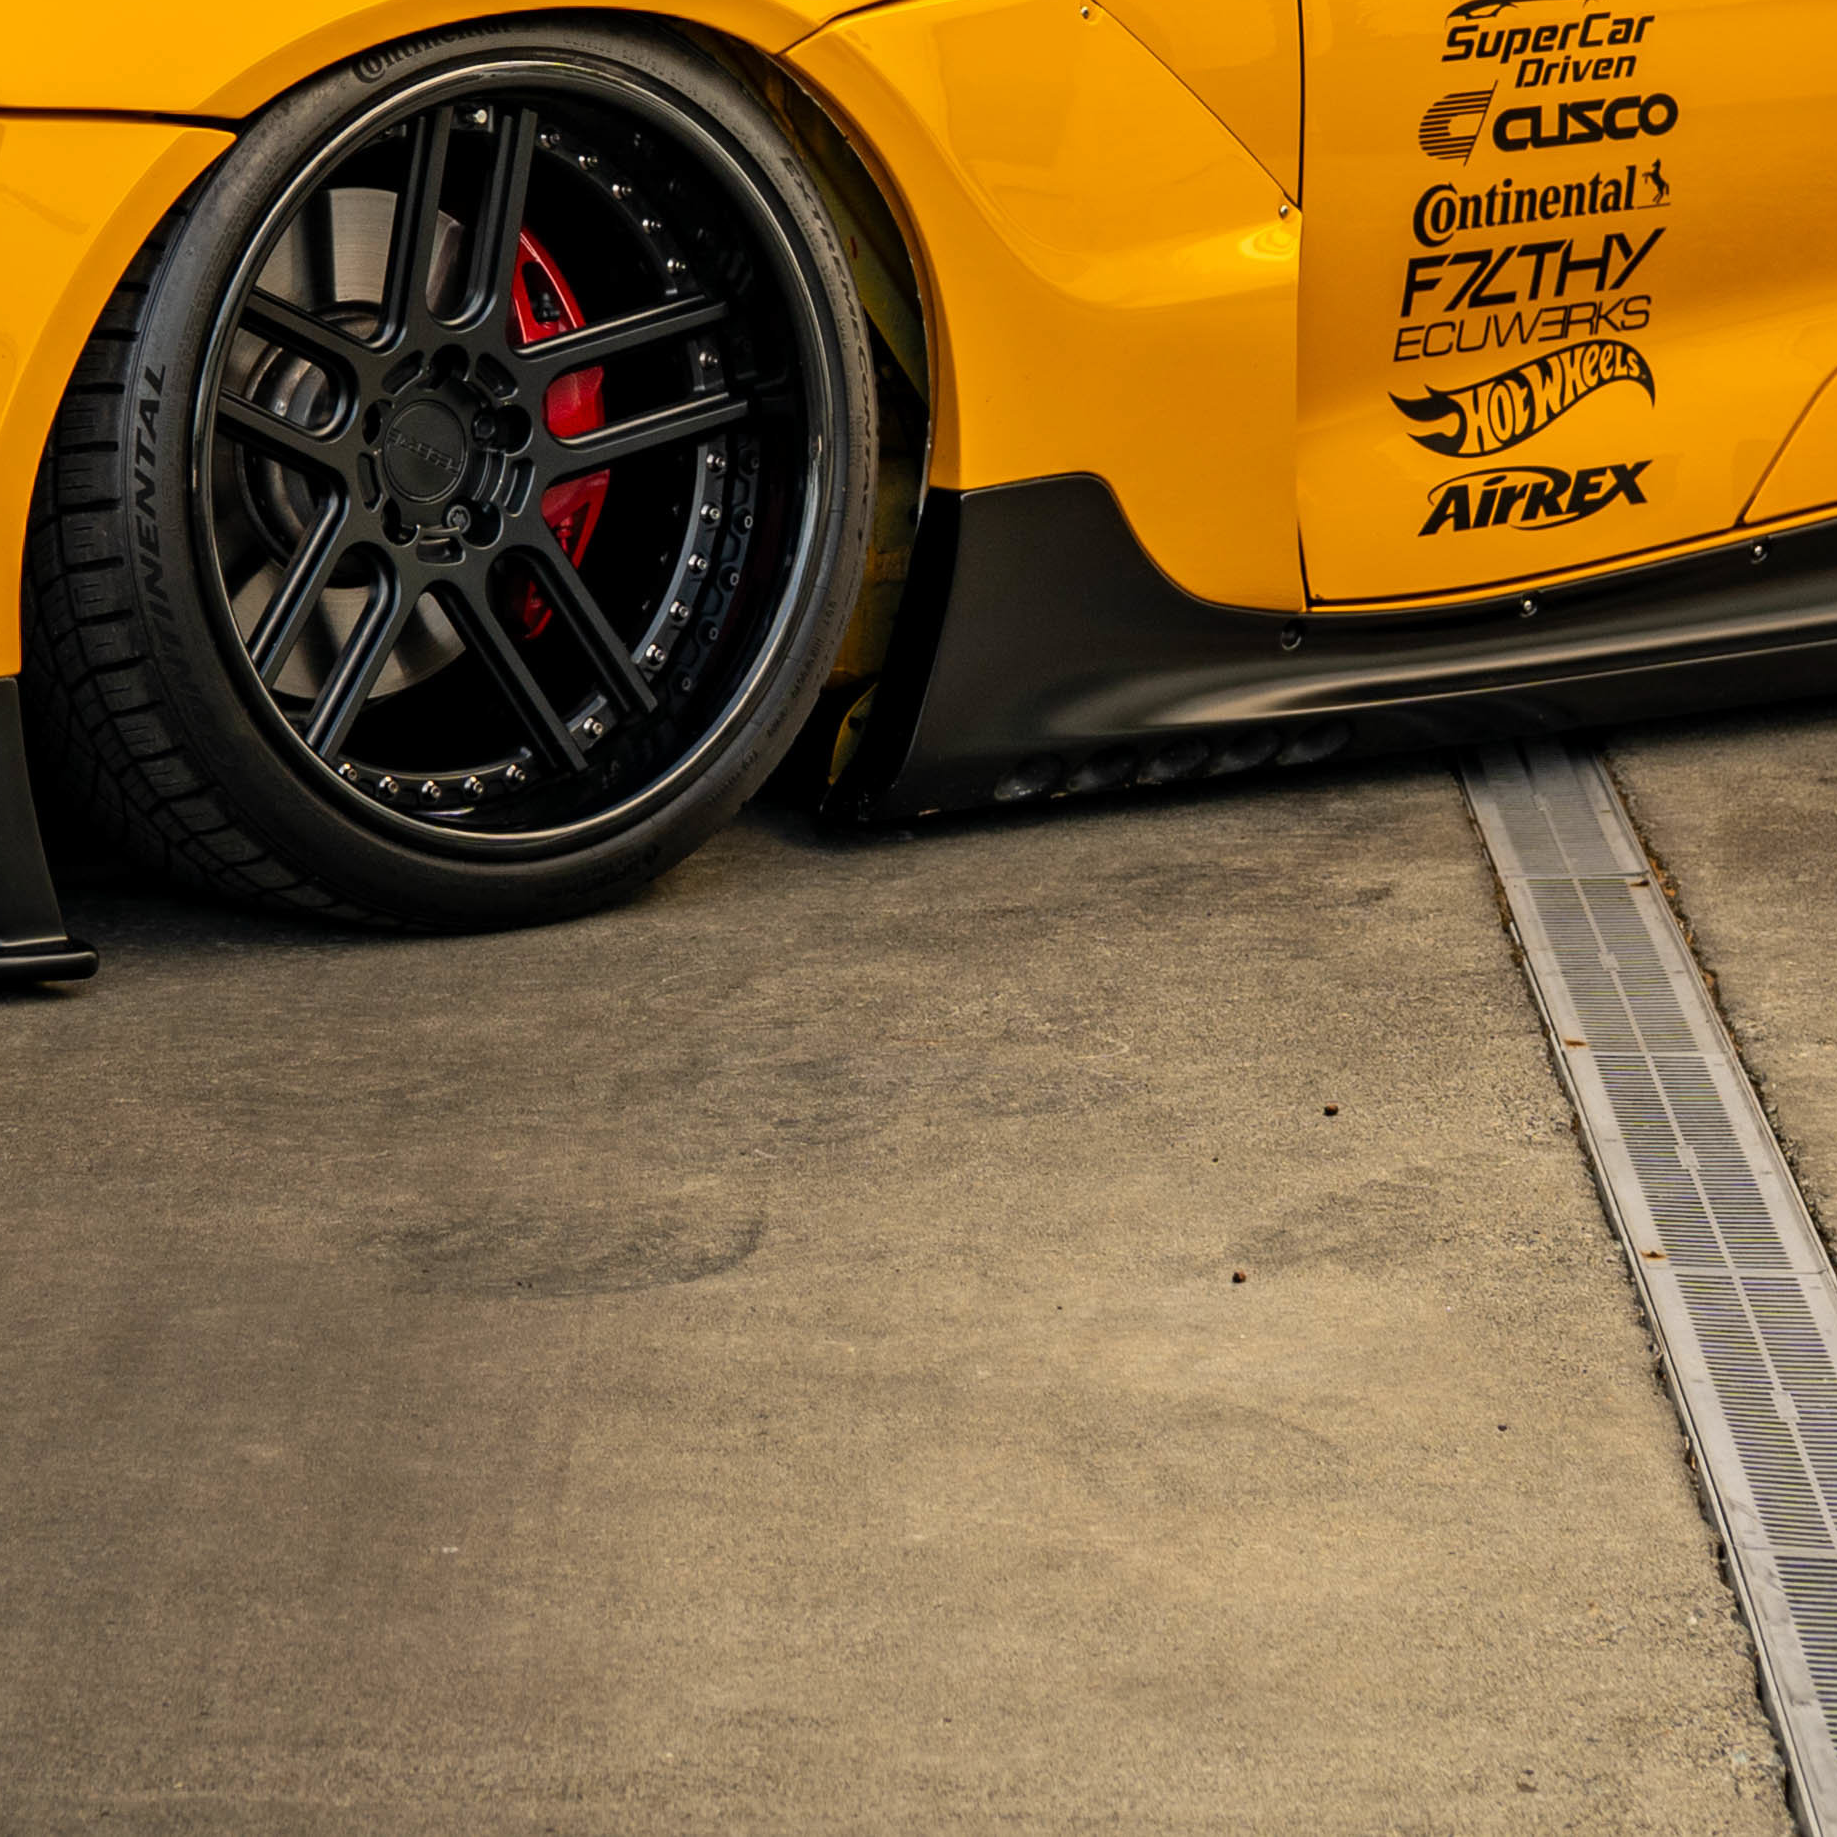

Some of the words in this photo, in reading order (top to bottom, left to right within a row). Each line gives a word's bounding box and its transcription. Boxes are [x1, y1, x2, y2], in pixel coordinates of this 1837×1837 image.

[1441, 12, 1656, 64] SuperCar
[1515, 55, 1637, 89] Driven
[1412, 163, 1637, 248] Continental
